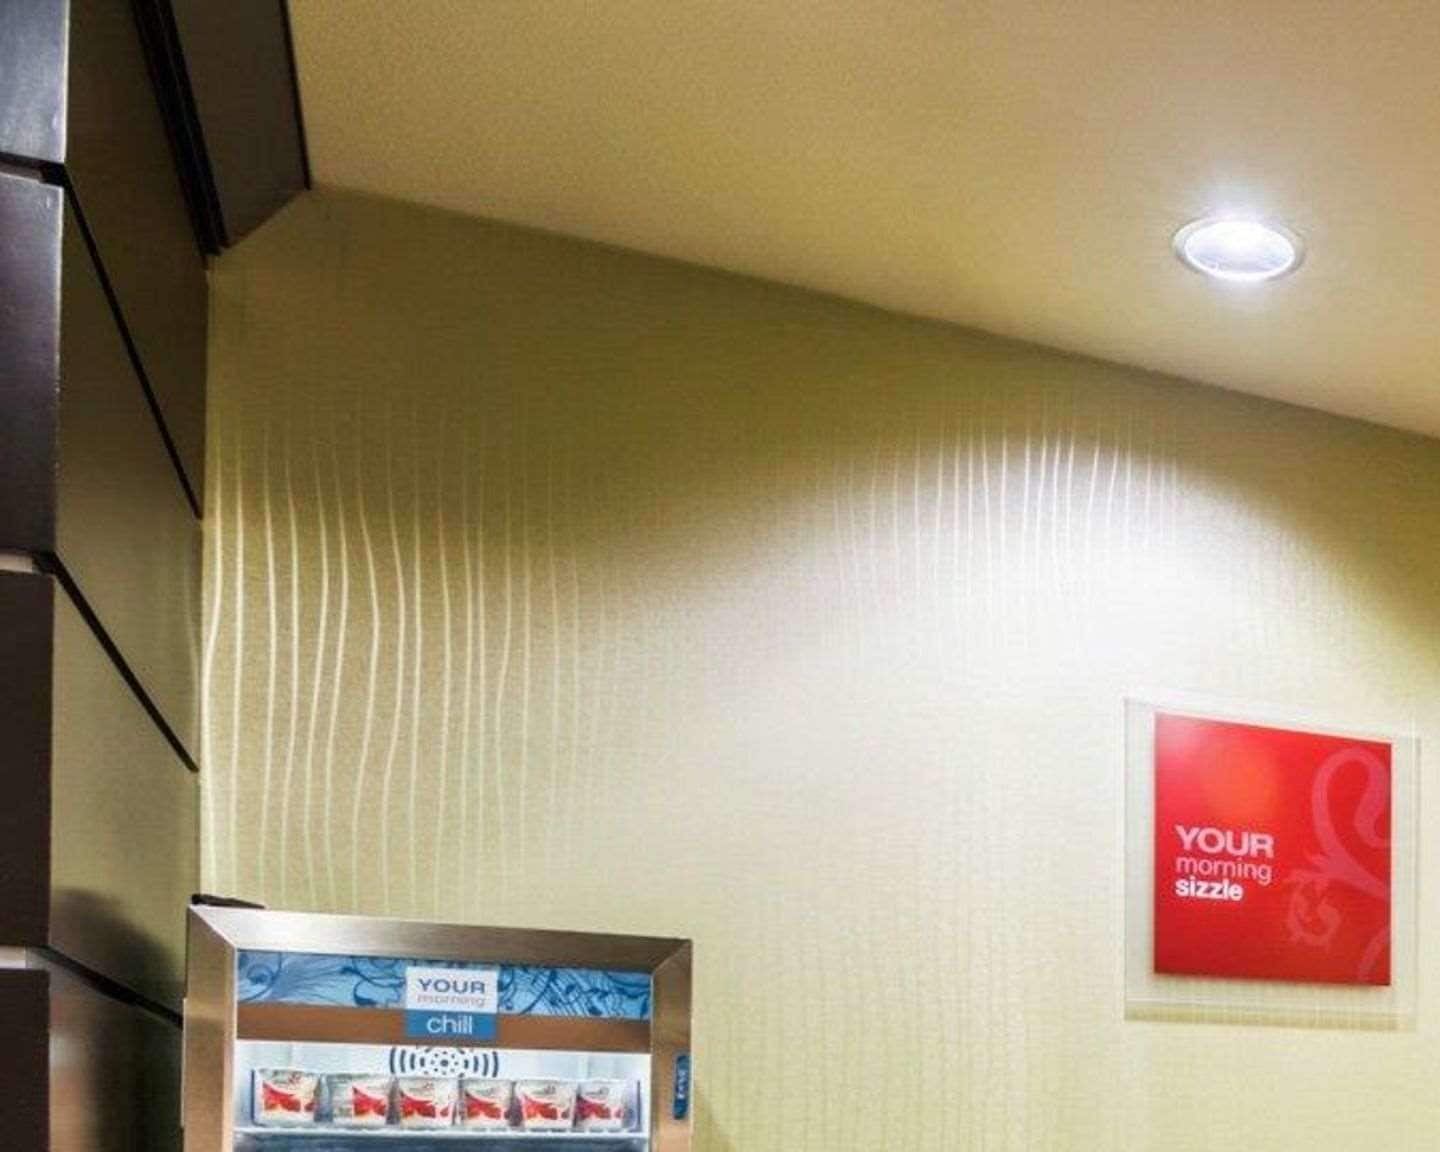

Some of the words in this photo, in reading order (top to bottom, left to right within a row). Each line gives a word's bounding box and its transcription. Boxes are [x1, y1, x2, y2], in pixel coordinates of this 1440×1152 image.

[1174, 824, 1275, 859] YOUR
[1175, 856, 1272, 886] morning
[1175, 875, 1244, 902] sizzle
[418, 978, 486, 995] YOUR
[426, 1013, 473, 1035] chill
